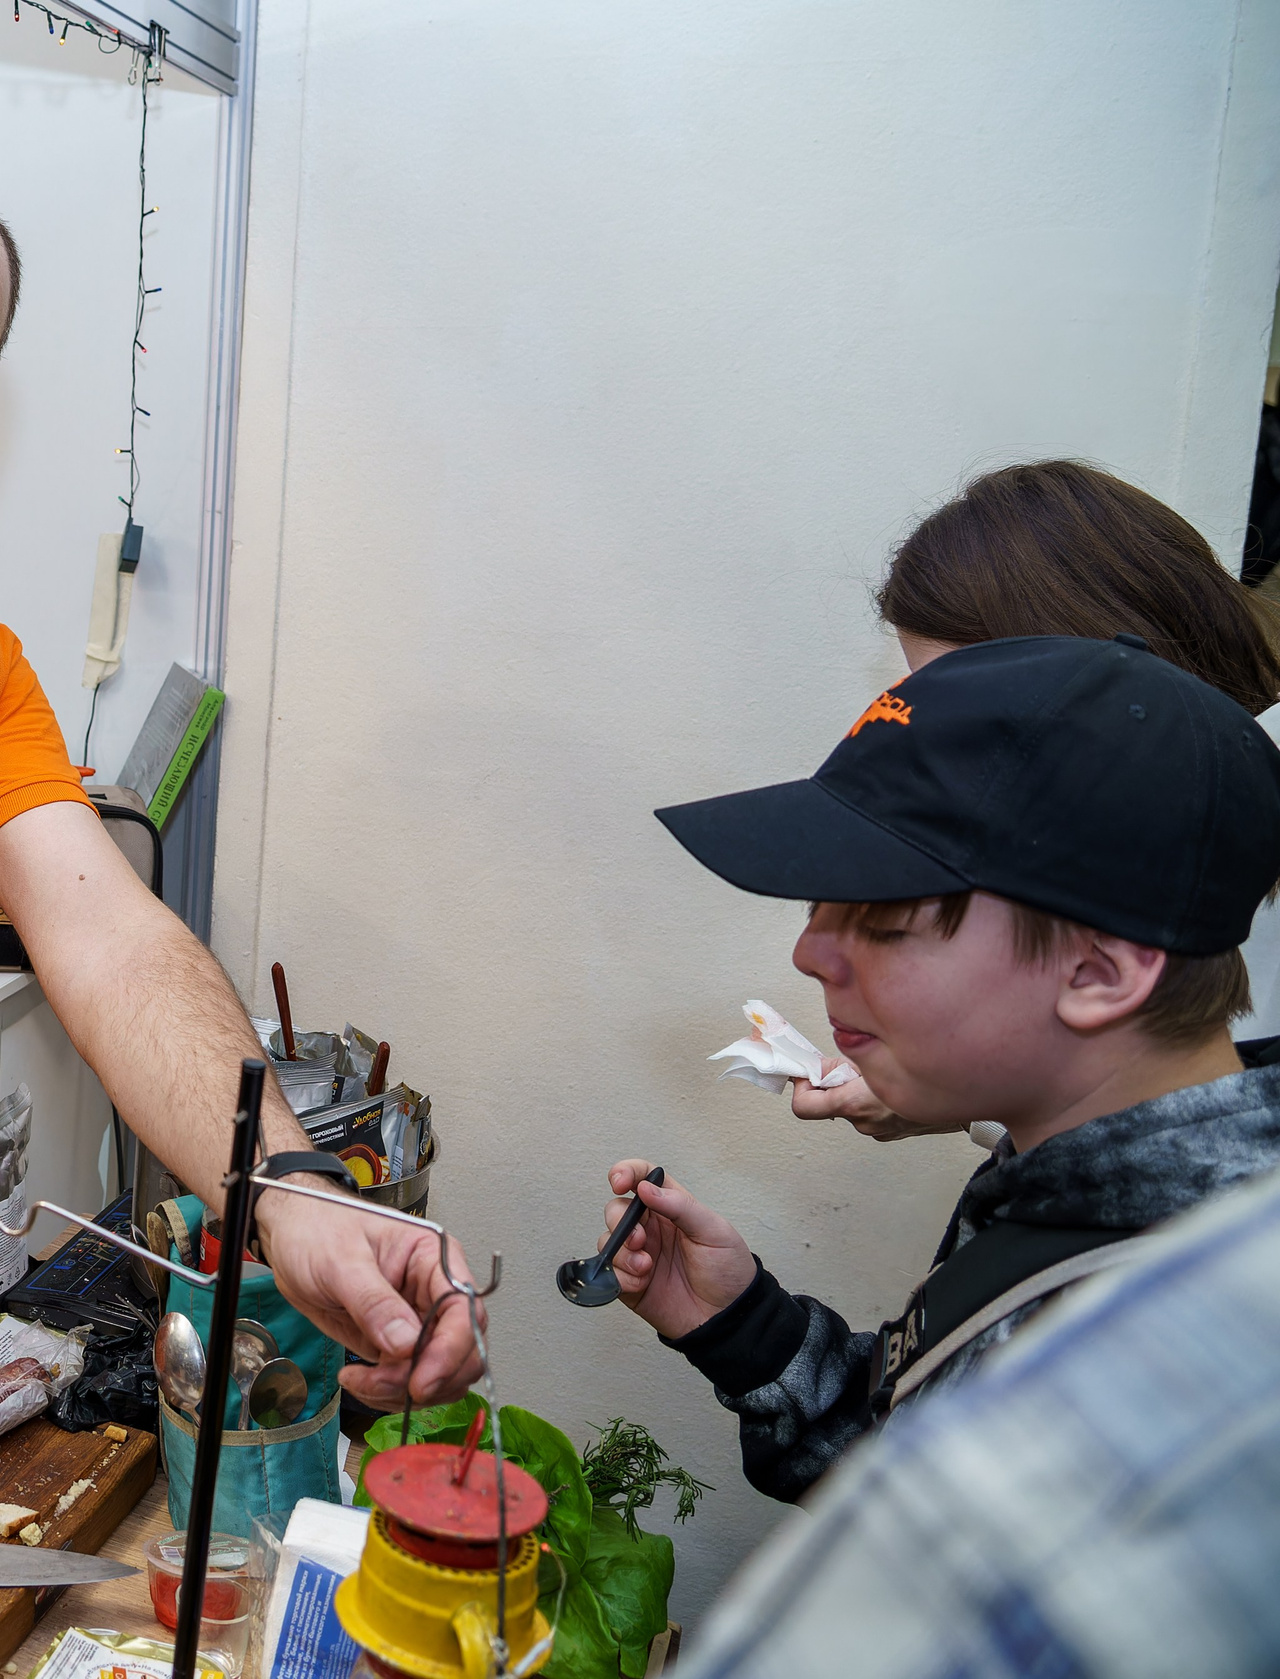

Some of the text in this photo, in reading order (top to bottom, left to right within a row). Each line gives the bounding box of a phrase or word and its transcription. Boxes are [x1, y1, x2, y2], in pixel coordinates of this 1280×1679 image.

[158, 734, 199, 808] ИСЧЕЗАЮЩИЙ
[311, 1124, 345, 1140] ГОРОХОВЫЙ
[355, 1109, 382, 1128] Удобная
[283, 1624, 295, 1660] бумажные
[291, 1592, 302, 1624] торговой
[299, 1570, 309, 1593] марки
[308, 1605, 321, 1639] бытового
